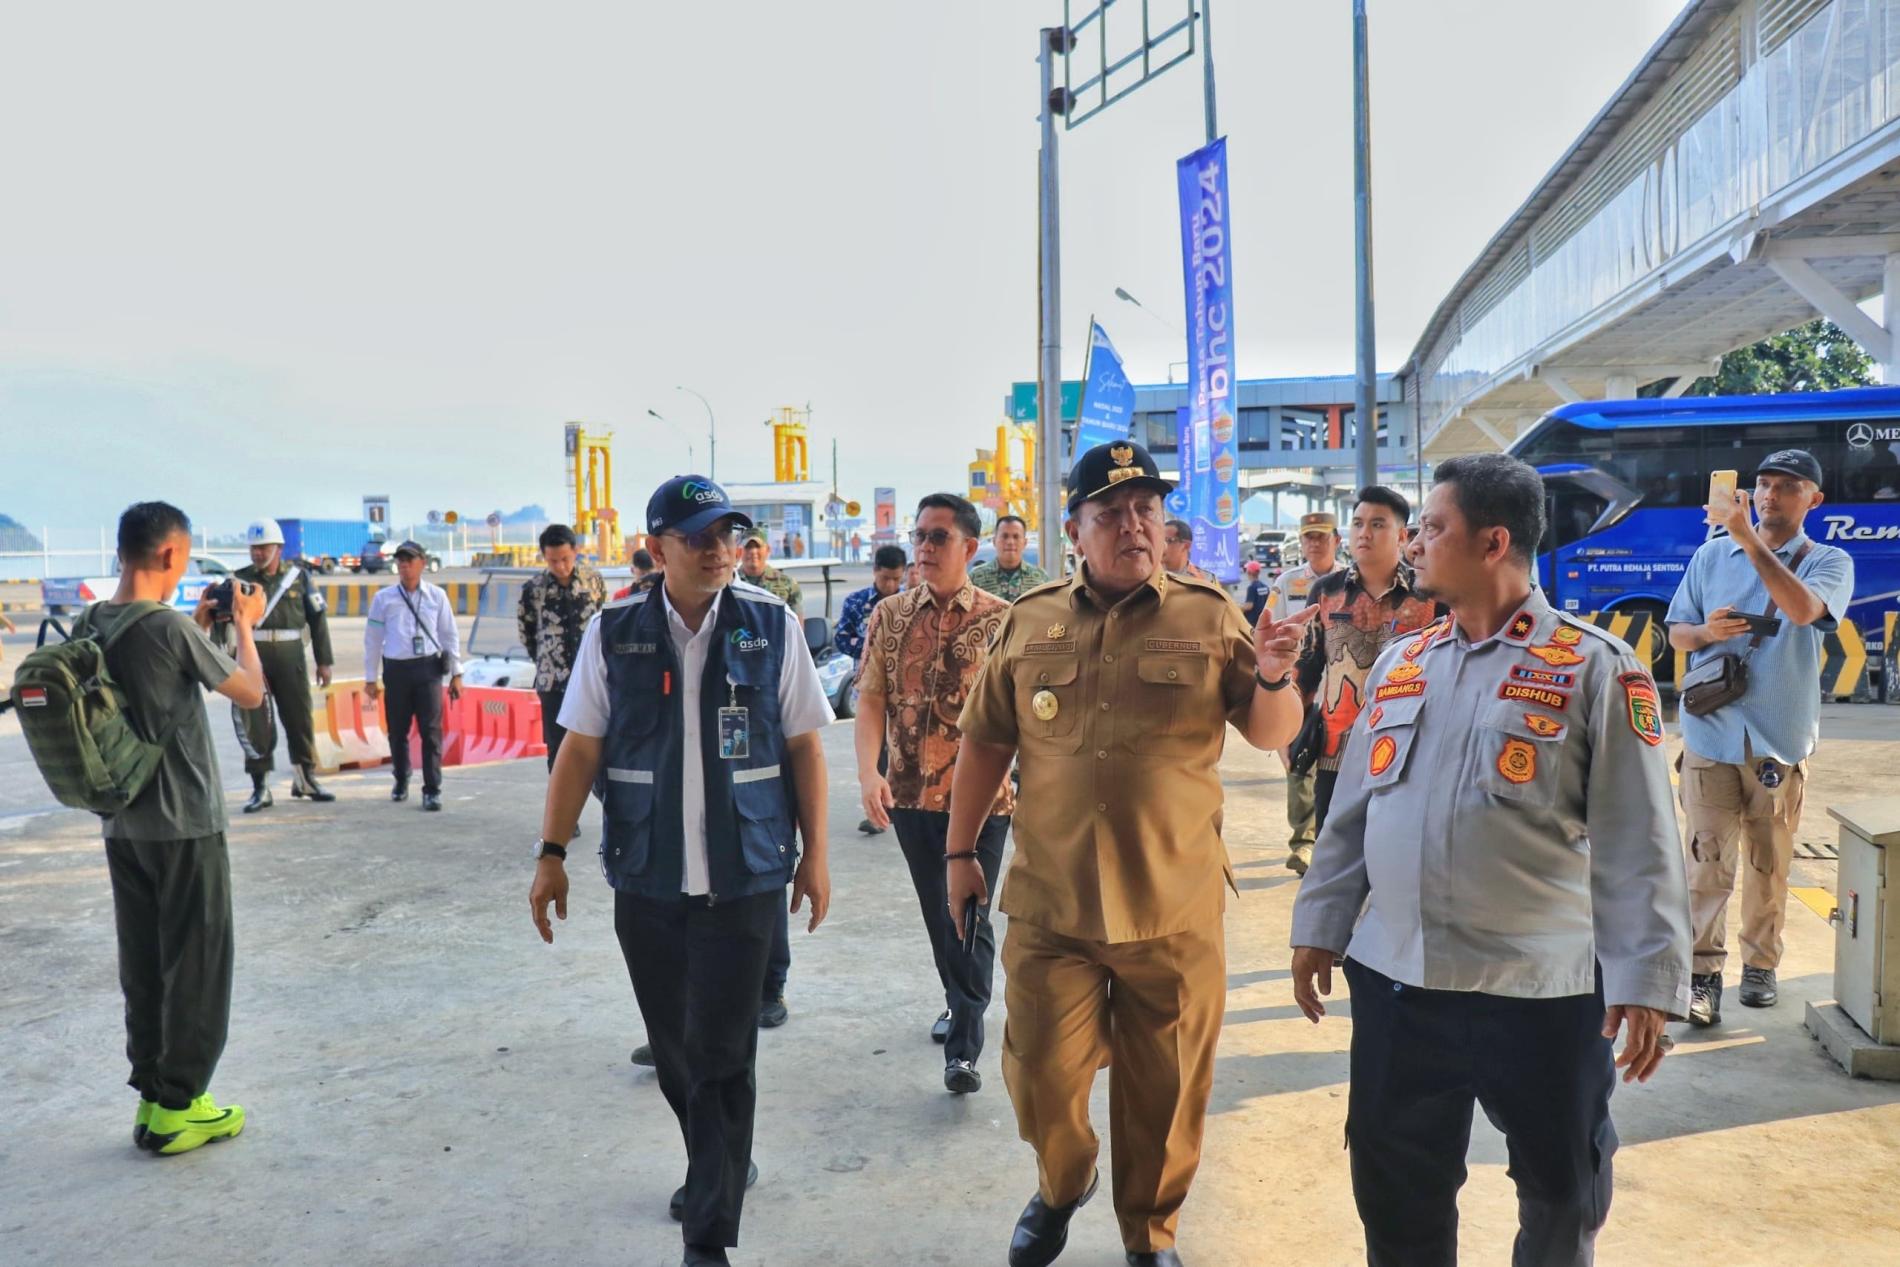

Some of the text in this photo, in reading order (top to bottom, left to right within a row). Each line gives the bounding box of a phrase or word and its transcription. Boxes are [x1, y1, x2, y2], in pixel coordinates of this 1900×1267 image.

[1191, 211, 1202, 269] Baru
[1199, 160, 1229, 401] bhc 2024
[1194, 270, 1204, 345] Tahun
[1588, 563, 1685, 572] PT. PUTRA REMAJA SENTOSA
[739, 637, 768, 649] asdp
[1505, 686, 1562, 707] DISHUB
